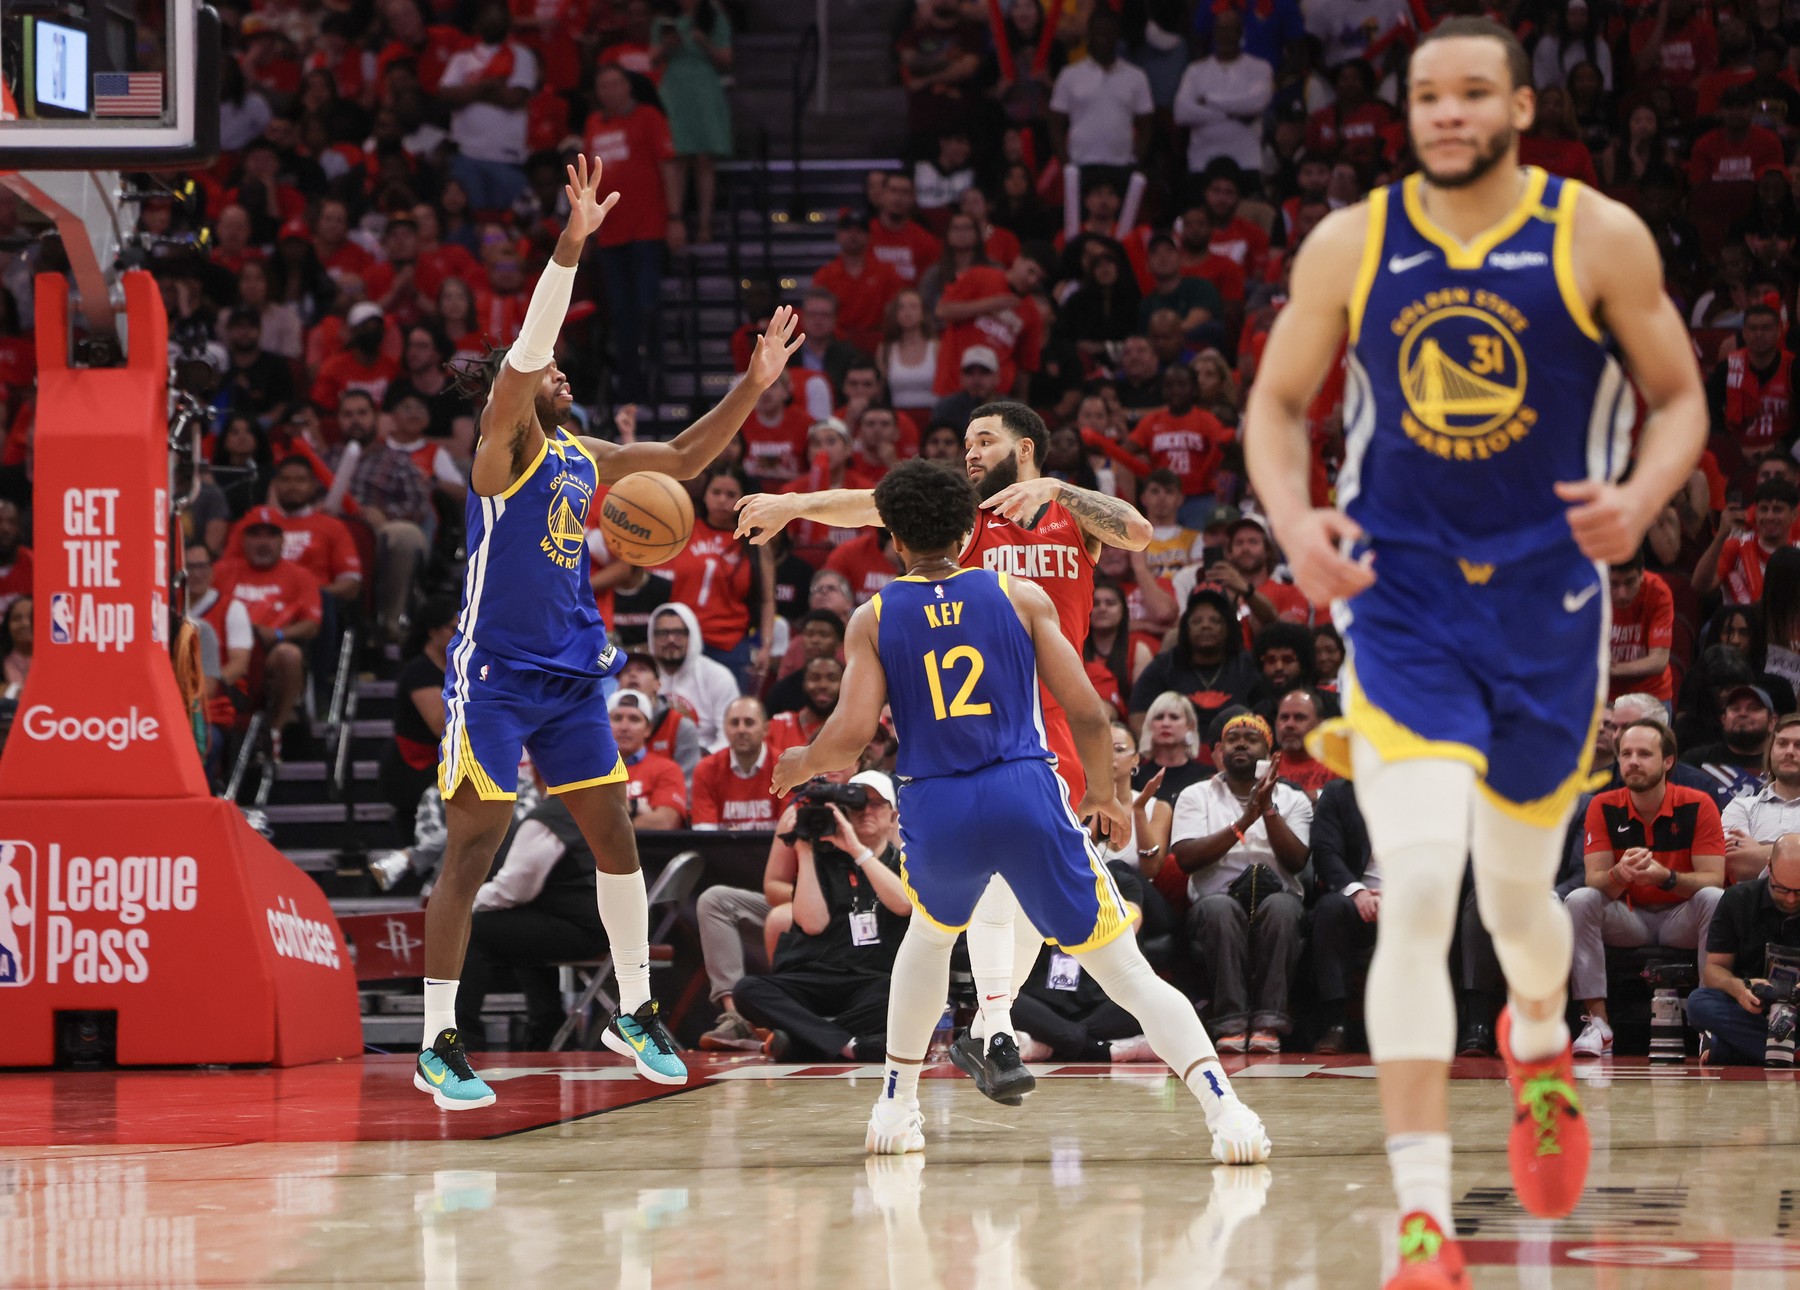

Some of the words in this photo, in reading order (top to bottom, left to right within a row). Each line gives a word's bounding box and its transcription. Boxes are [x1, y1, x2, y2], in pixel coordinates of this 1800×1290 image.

[1467, 334, 1505, 375] 31
[1401, 404, 1539, 461] WARRIORS
[569, 474, 594, 497] STATE
[578, 498, 587, 520] 7
[63, 488, 120, 537] GET
[603, 500, 652, 541] Wilson
[63, 540, 121, 588] THE
[983, 544, 1079, 579] ROCKETS
[77, 593, 135, 652] App
[923, 601, 964, 629] KEY
[923, 645, 992, 721] 12
[22, 704, 160, 751] Google
[722, 800, 773, 820] ALWAYS
[47, 843, 198, 925] League
[46, 915, 150, 984] Pass
[266, 895, 340, 970] coinbase
